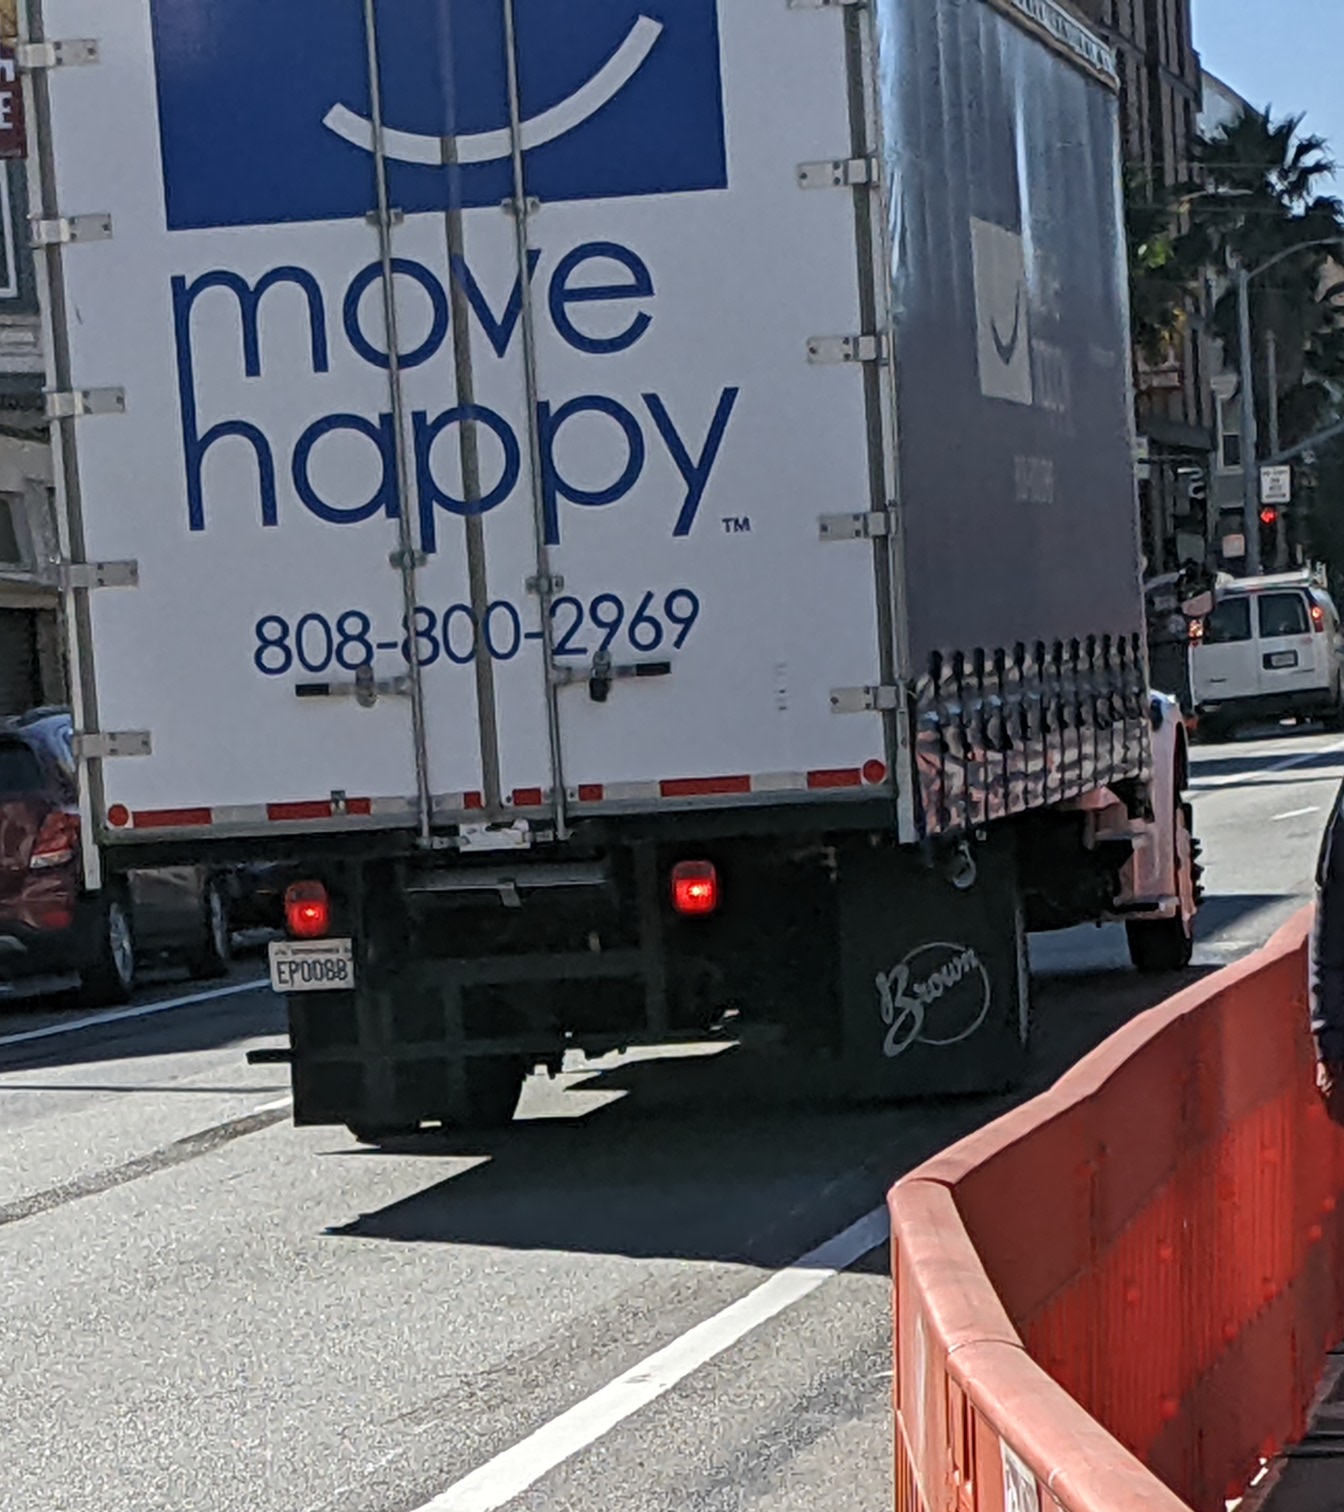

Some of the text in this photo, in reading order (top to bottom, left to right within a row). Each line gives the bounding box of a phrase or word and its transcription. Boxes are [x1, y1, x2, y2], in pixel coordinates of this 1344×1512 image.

[170, 241, 654, 377] move
[176, 385, 740, 554] happy
[254, 588, 699, 675] 808-800-2969
